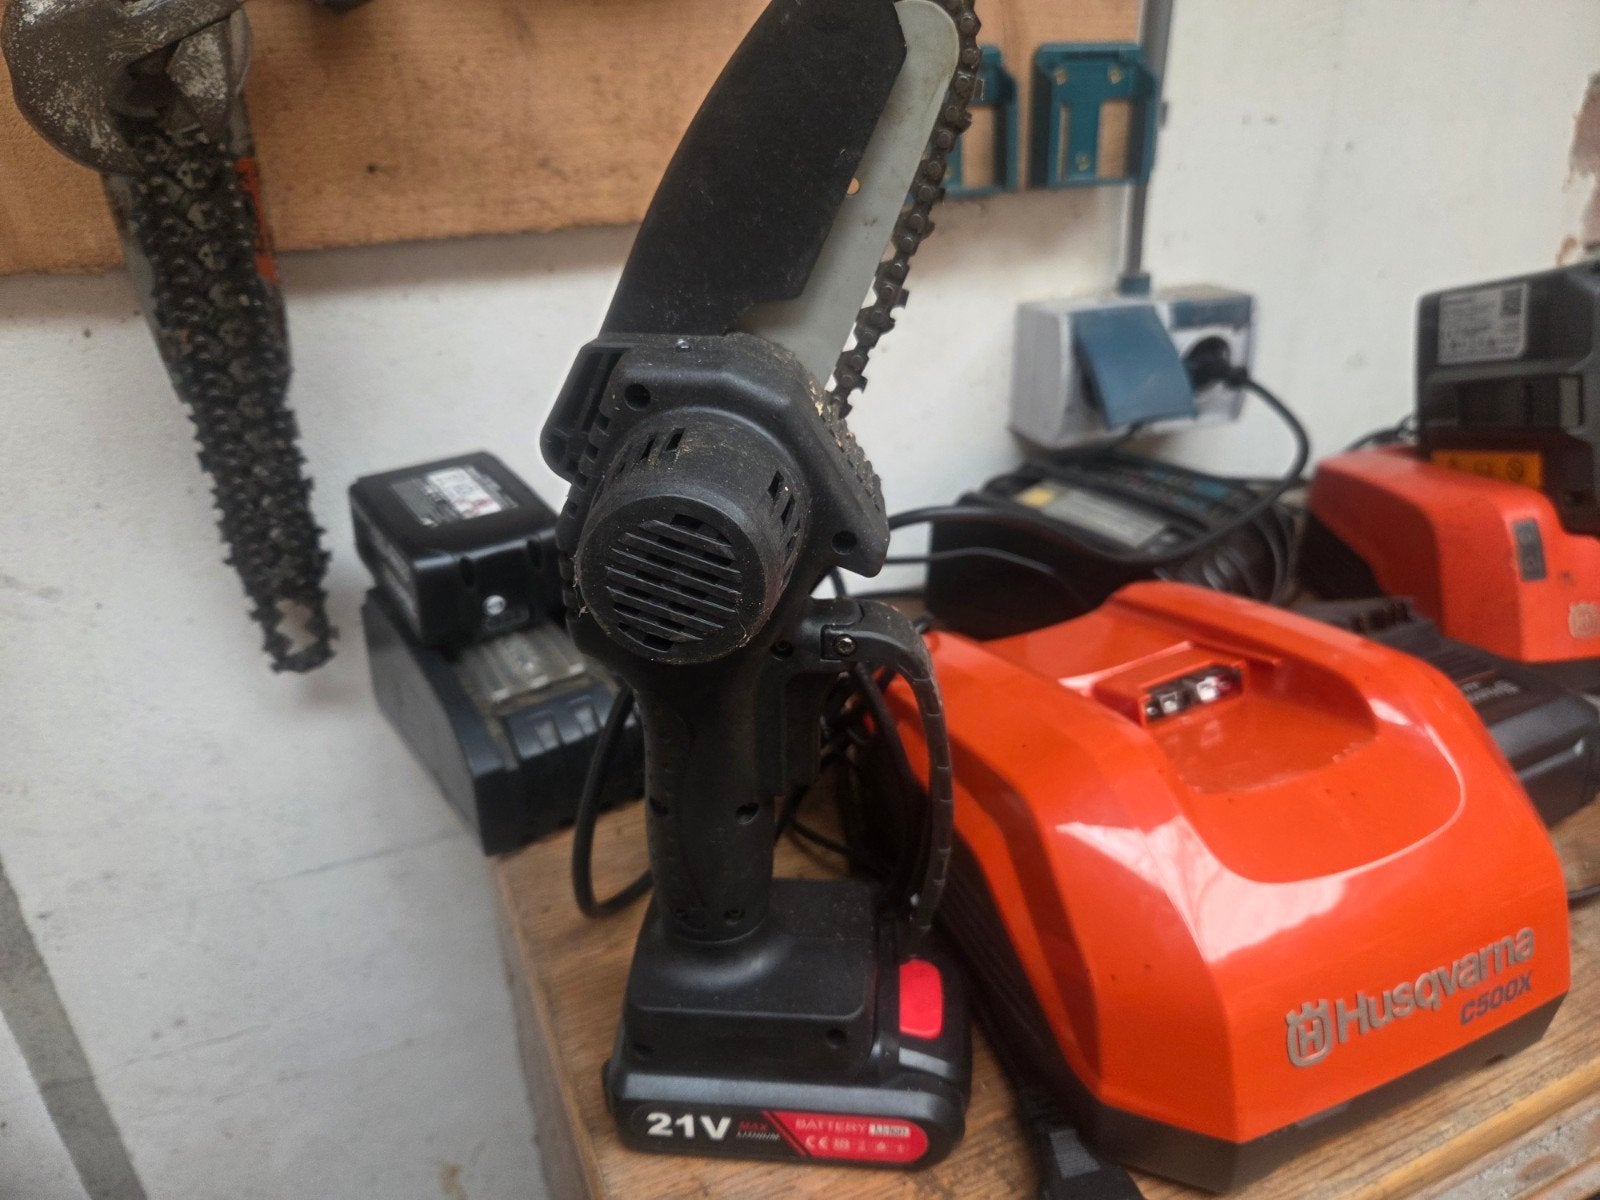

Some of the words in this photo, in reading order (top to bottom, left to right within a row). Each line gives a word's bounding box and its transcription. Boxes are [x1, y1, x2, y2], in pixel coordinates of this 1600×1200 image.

[1335, 926, 1535, 1044] Husqvarna
[1460, 972, 1532, 1025] C500X
[646, 1112, 731, 1139] 21V
[795, 1118, 866, 1132] BATTERY
